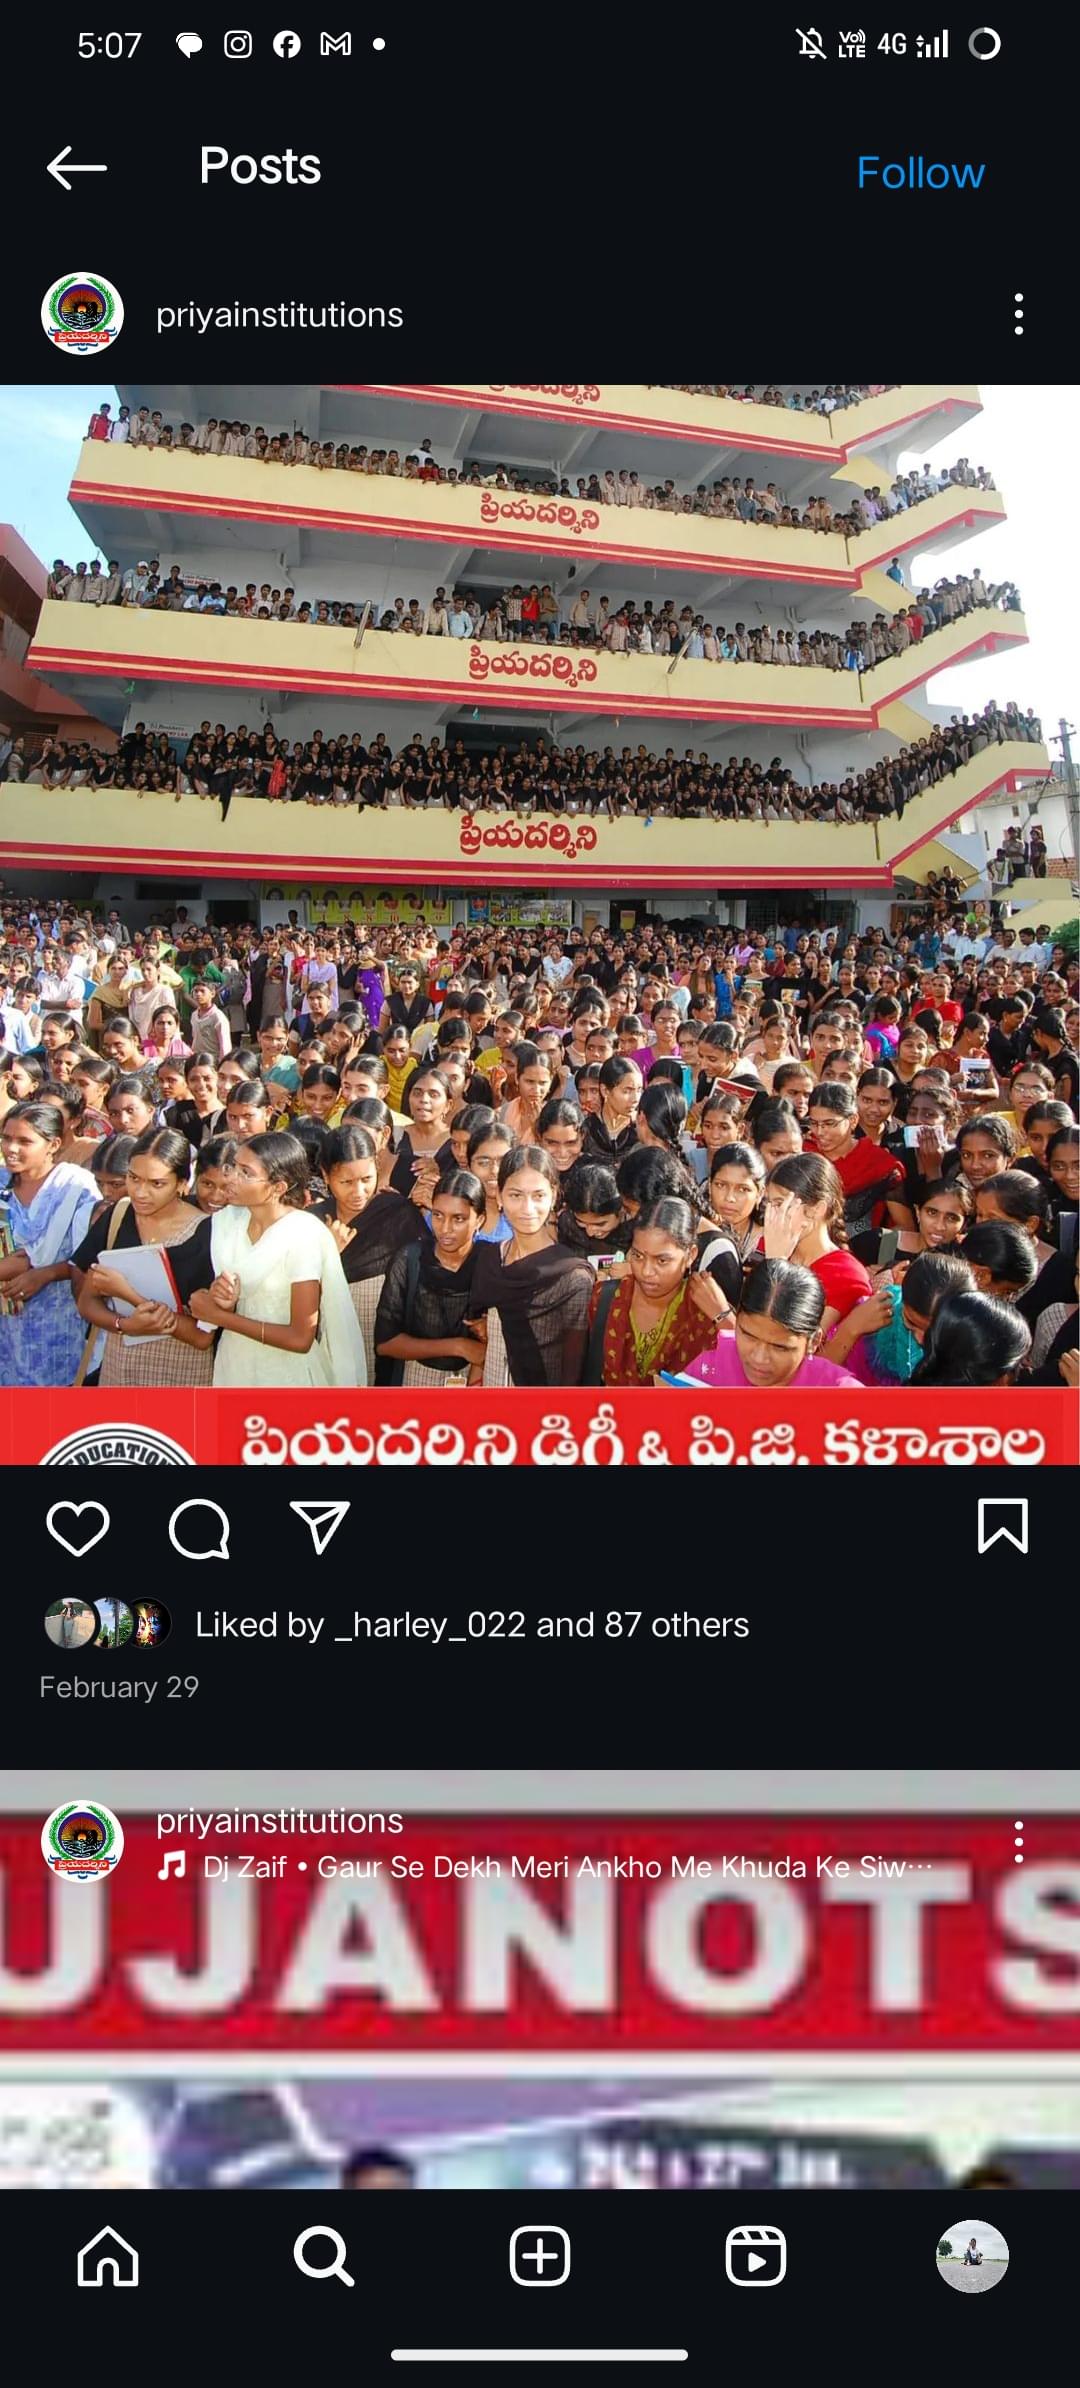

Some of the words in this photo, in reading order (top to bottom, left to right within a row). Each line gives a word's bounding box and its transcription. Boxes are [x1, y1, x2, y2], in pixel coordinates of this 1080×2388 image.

[78, 31, 143, 59] 5:07
[838, 45, 866, 59] LTE
[876, 32, 907, 55] 4G
[201, 145, 322, 185] Posts
[858, 155, 986, 190] Follow
[157, 300, 404, 334] priyainstitutions
[480, 493, 600, 534] ప్రియదర్శిని
[469, 645, 598, 688] ప్రియదర్శిని
[460, 815, 598, 859] ప్రియదర్శిని
[196, 1610, 277, 1638] Liked
[288, 1611, 325, 1644] by
[334, 1610, 526, 1644] _harley_022
[536, 1610, 594, 1638] and
[604, 1610, 643, 1638] 87
[651, 1611, 750, 1638] others
[40, 1675, 158, 1704] February
[166, 1675, 199, 1698] 29
[156, 1806, 404, 1840] priyainstitutions
[203, 1855, 229, 1884] Dj
[236, 1855, 287, 1879] Zaif
[318, 1855, 382, 1880] Gaur
[391, 1855, 424, 1879] Se
[435, 1855, 502, 1879] Dekh
[511, 1855, 568, 1879] Meri
[577, 1855, 661, 1879] Ankho
[671, 1855, 712, 1879] Me
[722, 1855, 806, 1879] Khuda
[817, 1855, 850, 1879] Ke
